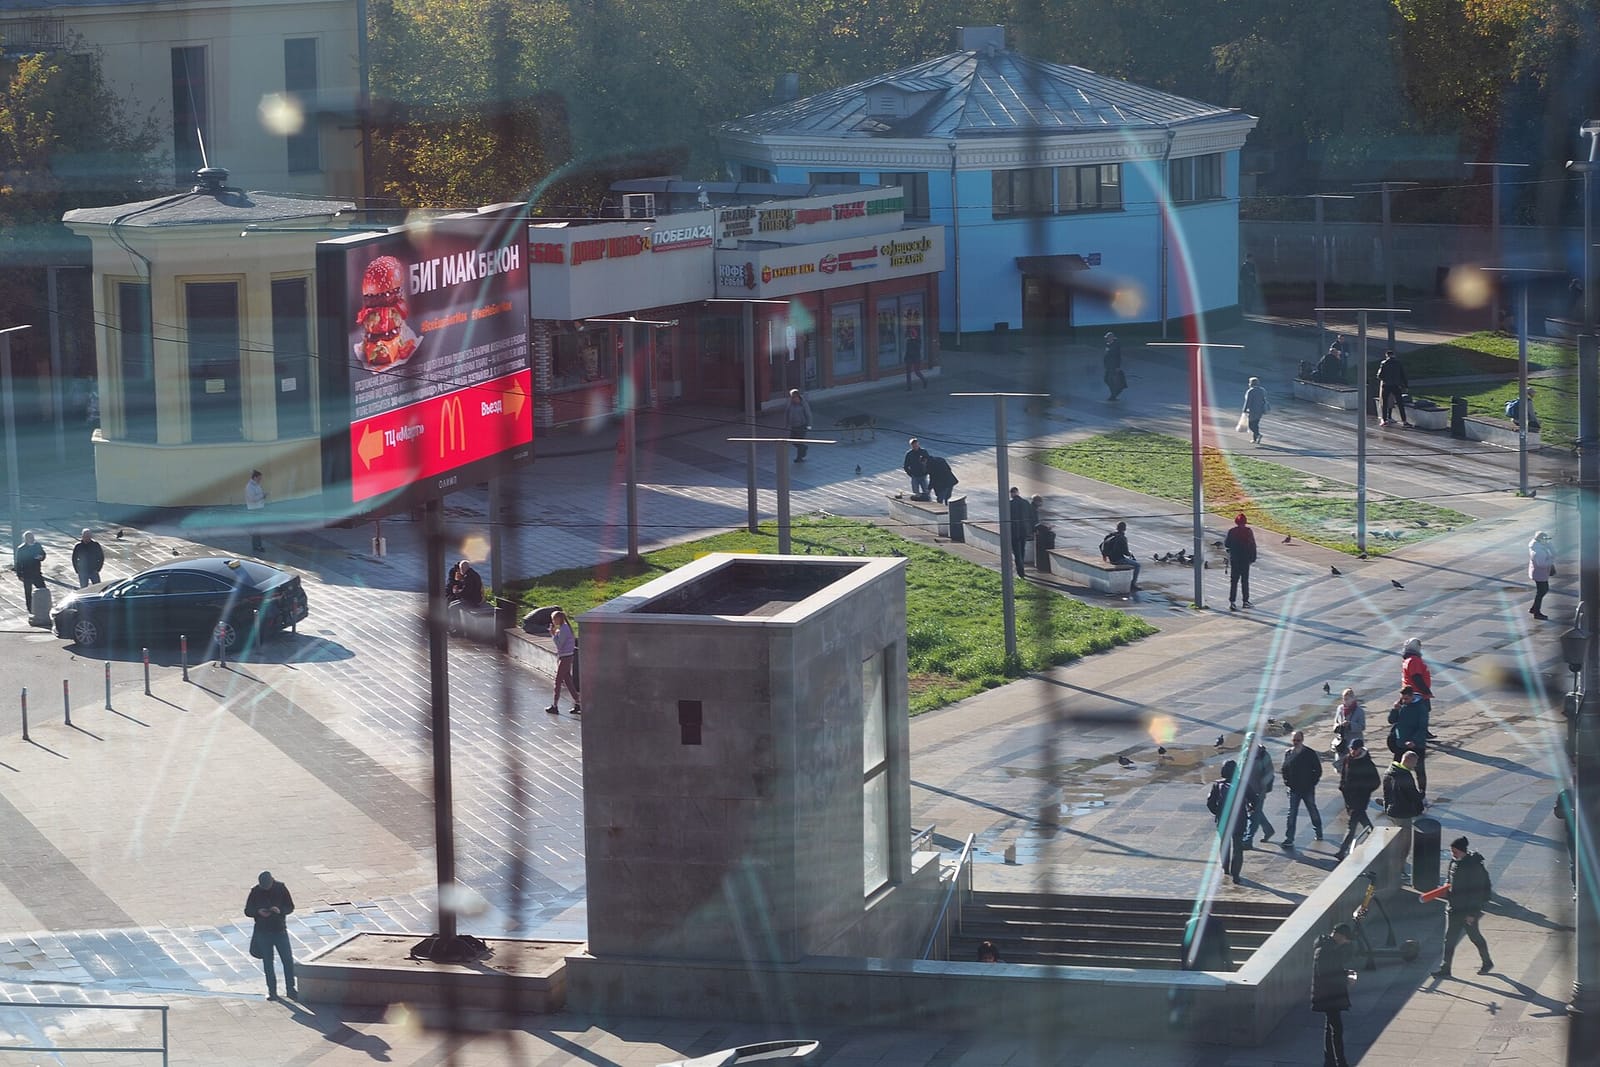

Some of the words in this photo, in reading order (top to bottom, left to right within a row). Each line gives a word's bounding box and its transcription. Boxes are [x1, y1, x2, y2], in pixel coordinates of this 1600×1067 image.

[409, 258, 440, 295] БИГ
[442, 250, 477, 287] МАК
[478, 245, 520, 279] БЕКОН
[720, 264, 745, 278] КОФЕ
[481, 400, 503, 417] Въезд
[384, 429, 397, 447] ТЦ
